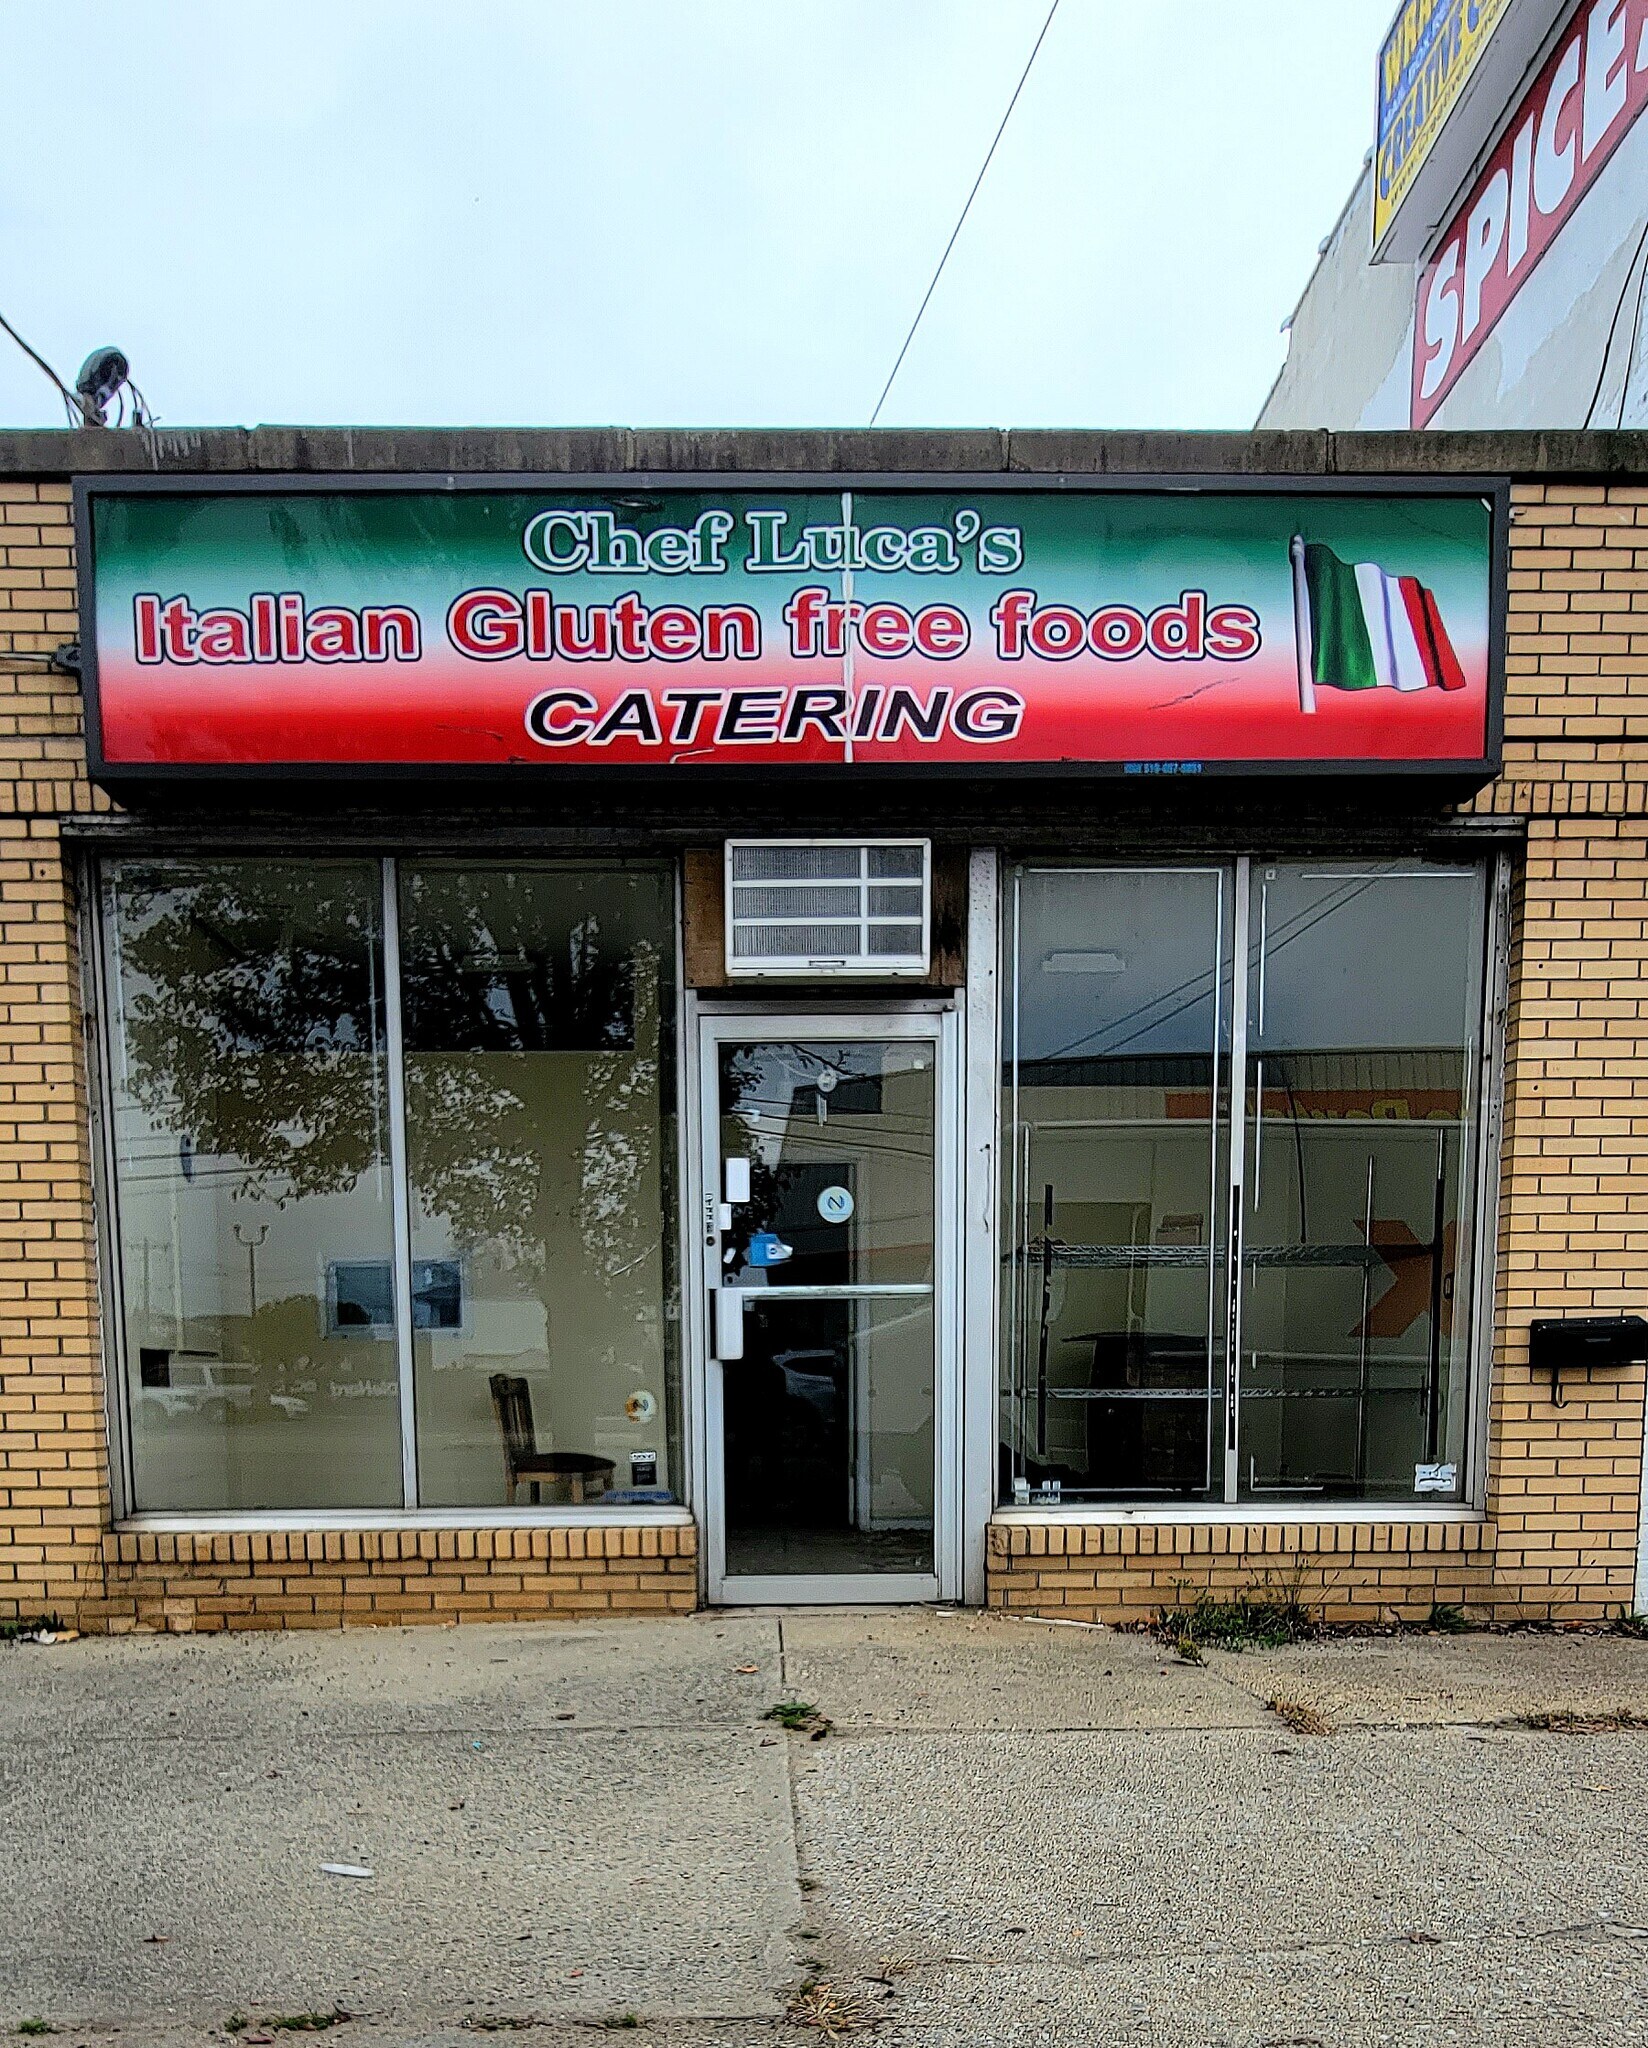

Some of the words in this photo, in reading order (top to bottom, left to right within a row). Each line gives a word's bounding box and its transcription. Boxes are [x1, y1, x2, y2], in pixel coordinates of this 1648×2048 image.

[1379, 0, 1463, 200] CREATIVE
[1419, 0, 1648, 399] SPICE
[524, 508, 735, 574] Chef
[744, 507, 1024, 573] Luca's
[133, 593, 422, 664] Italian
[445, 588, 762, 663] Gluten
[784, 586, 971, 661] free
[992, 588, 1262, 662] foods
[524, 686, 1026, 747] CATERING
